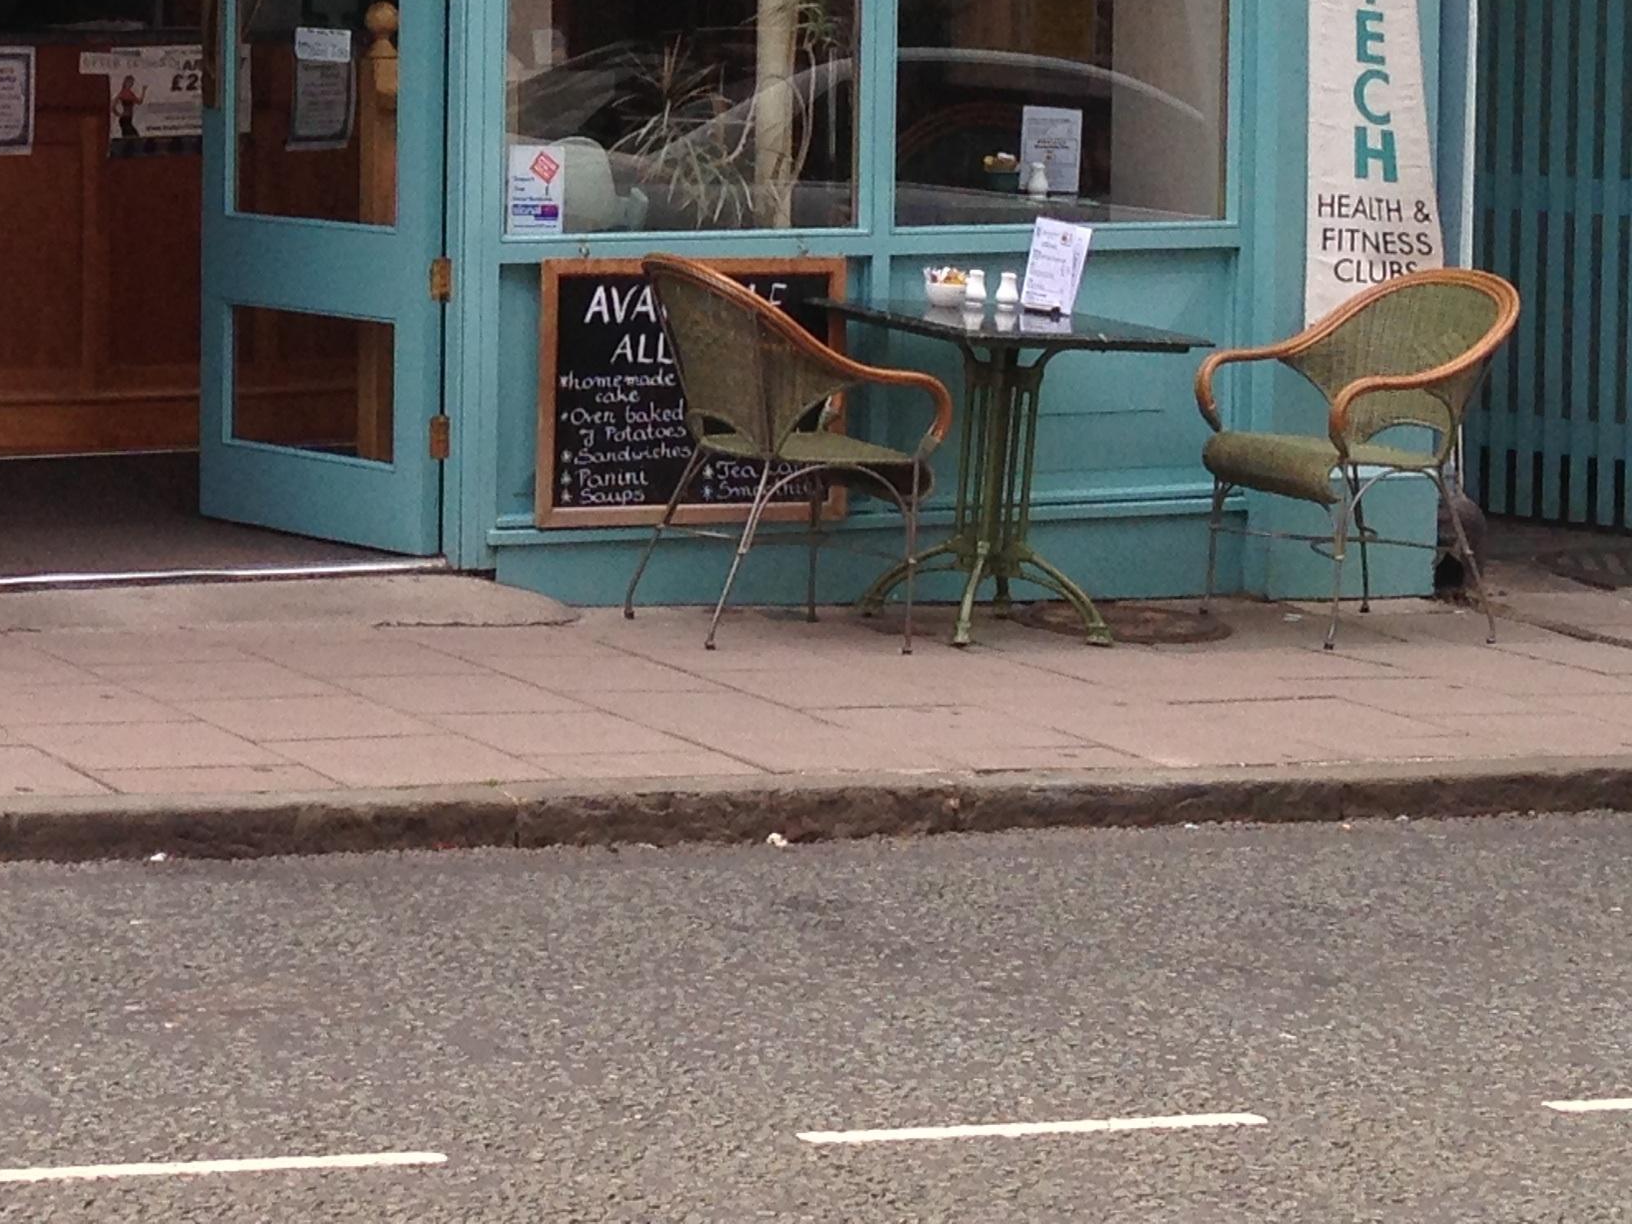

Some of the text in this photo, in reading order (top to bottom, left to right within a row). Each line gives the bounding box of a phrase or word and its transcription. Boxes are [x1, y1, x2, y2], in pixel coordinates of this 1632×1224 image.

[1317, 194, 1433, 224] HEALTH &
[1321, 228, 1434, 257] FITNESS
[610, 331, 674, 365] ALL
[595, 386, 640, 404] cake
[570, 397, 685, 425] Oven baked
[604, 423, 688, 443] Potatoes
[574, 441, 693, 465] Sandwiches
[576, 468, 649, 488] Panini
[578, 487, 646, 505] Soups
